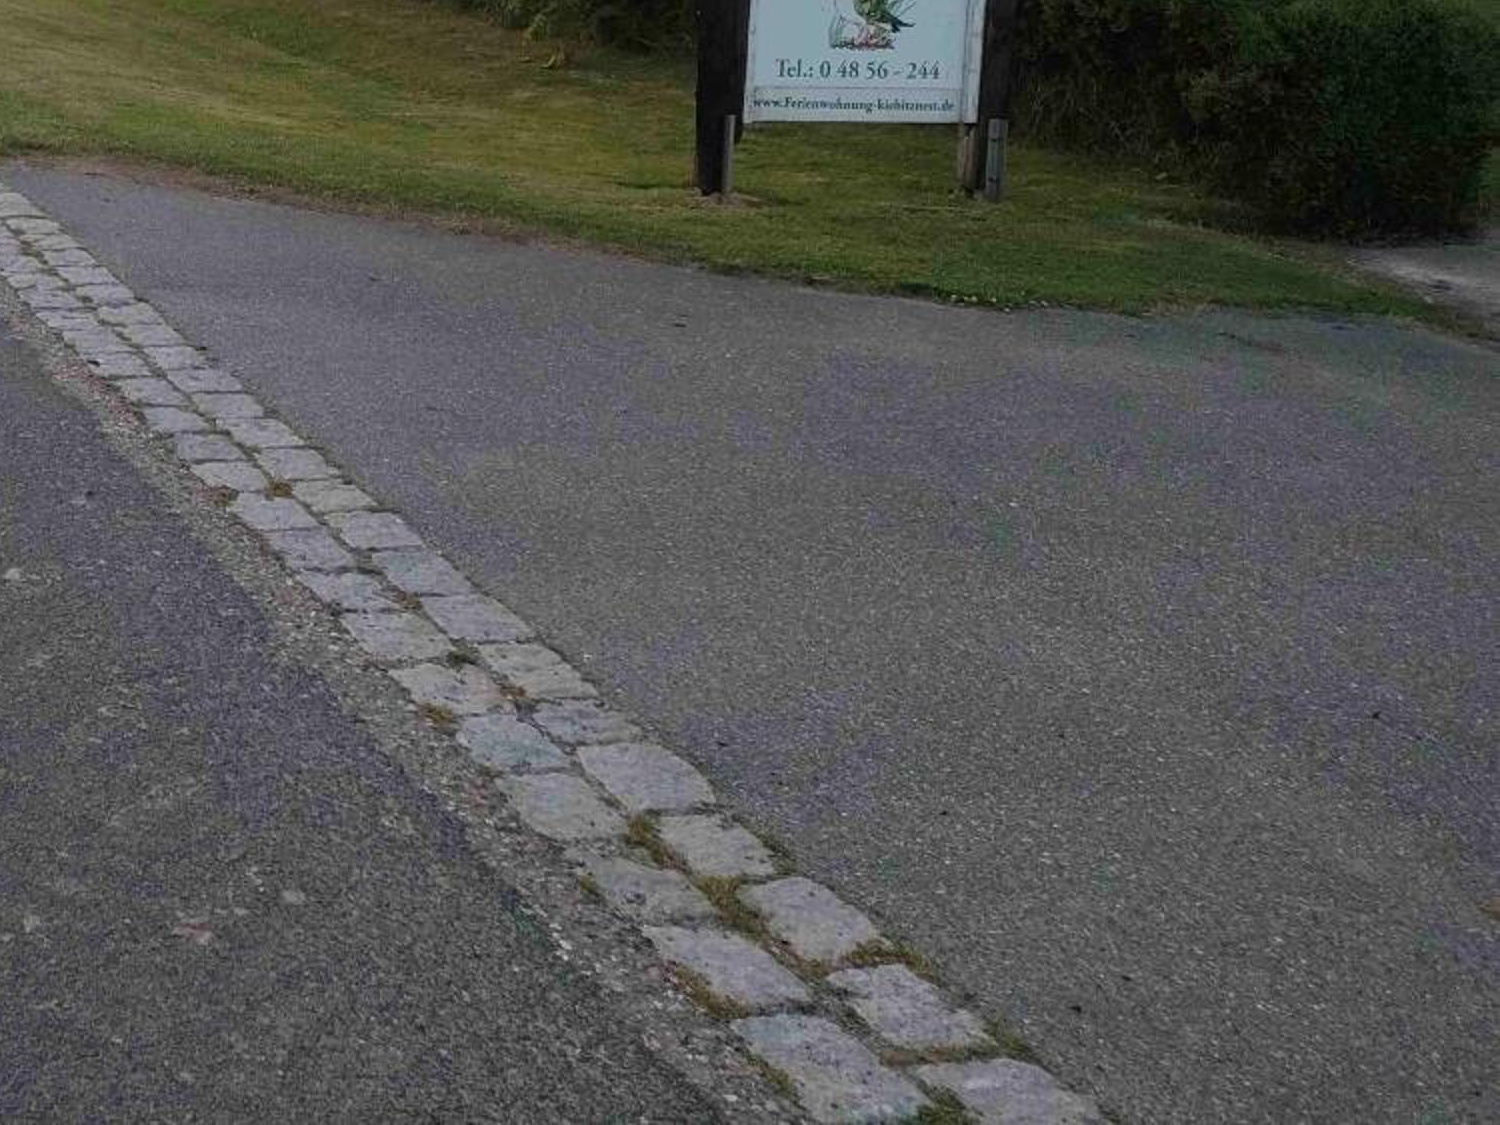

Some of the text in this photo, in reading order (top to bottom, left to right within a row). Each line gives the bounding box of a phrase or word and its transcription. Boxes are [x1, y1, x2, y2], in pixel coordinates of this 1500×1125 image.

[776, 58, 814, 79] Tel.:
[819, 60, 831, 79] 0
[836, 60, 859, 79] 48
[867, 61, 888, 80] 56
[906, 61, 941, 81] 244
